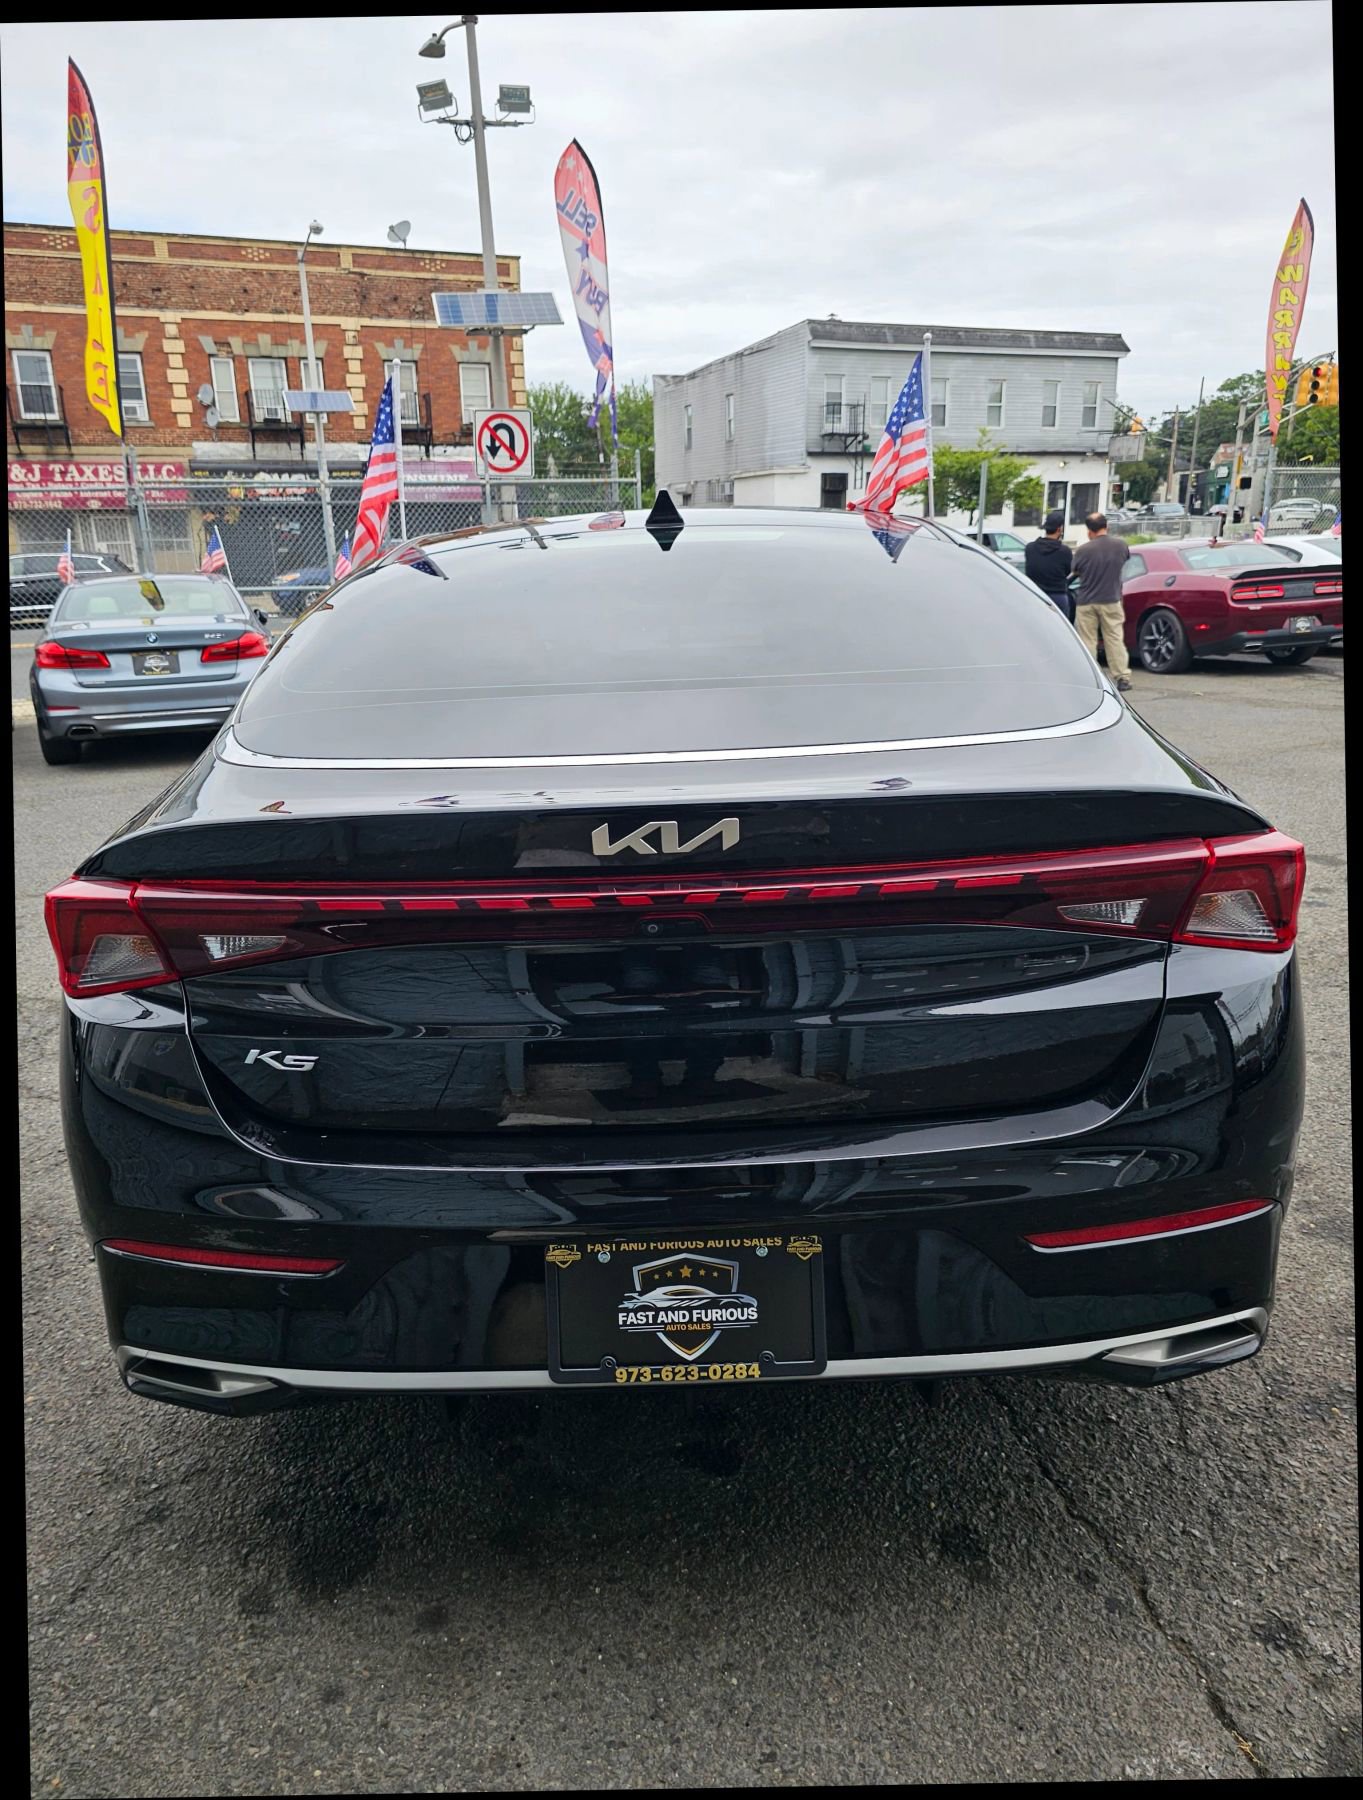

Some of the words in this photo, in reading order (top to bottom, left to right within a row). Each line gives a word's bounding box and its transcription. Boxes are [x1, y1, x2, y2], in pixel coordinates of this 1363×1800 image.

[8, 463, 41, 482] &J
[49, 464, 126, 482] TAXES
[592, 817, 740, 856] KIA
[244, 1049, 320, 1071] K5
[587, 1242, 616, 1252] FAST
[620, 1241, 647, 1251] AND
[650, 1240, 705, 1250] FURIOUS
[706, 1238, 741, 1248] AUTO
[743, 1236, 783, 1247] SALES
[618, 1311, 655, 1325] FAST
[657, 1310, 690, 1323] AND
[692, 1307, 758, 1322] FURIOUS
[687, 1322, 712, 1330] SALES
[615, 1361, 761, 1384] 973-623-0284
